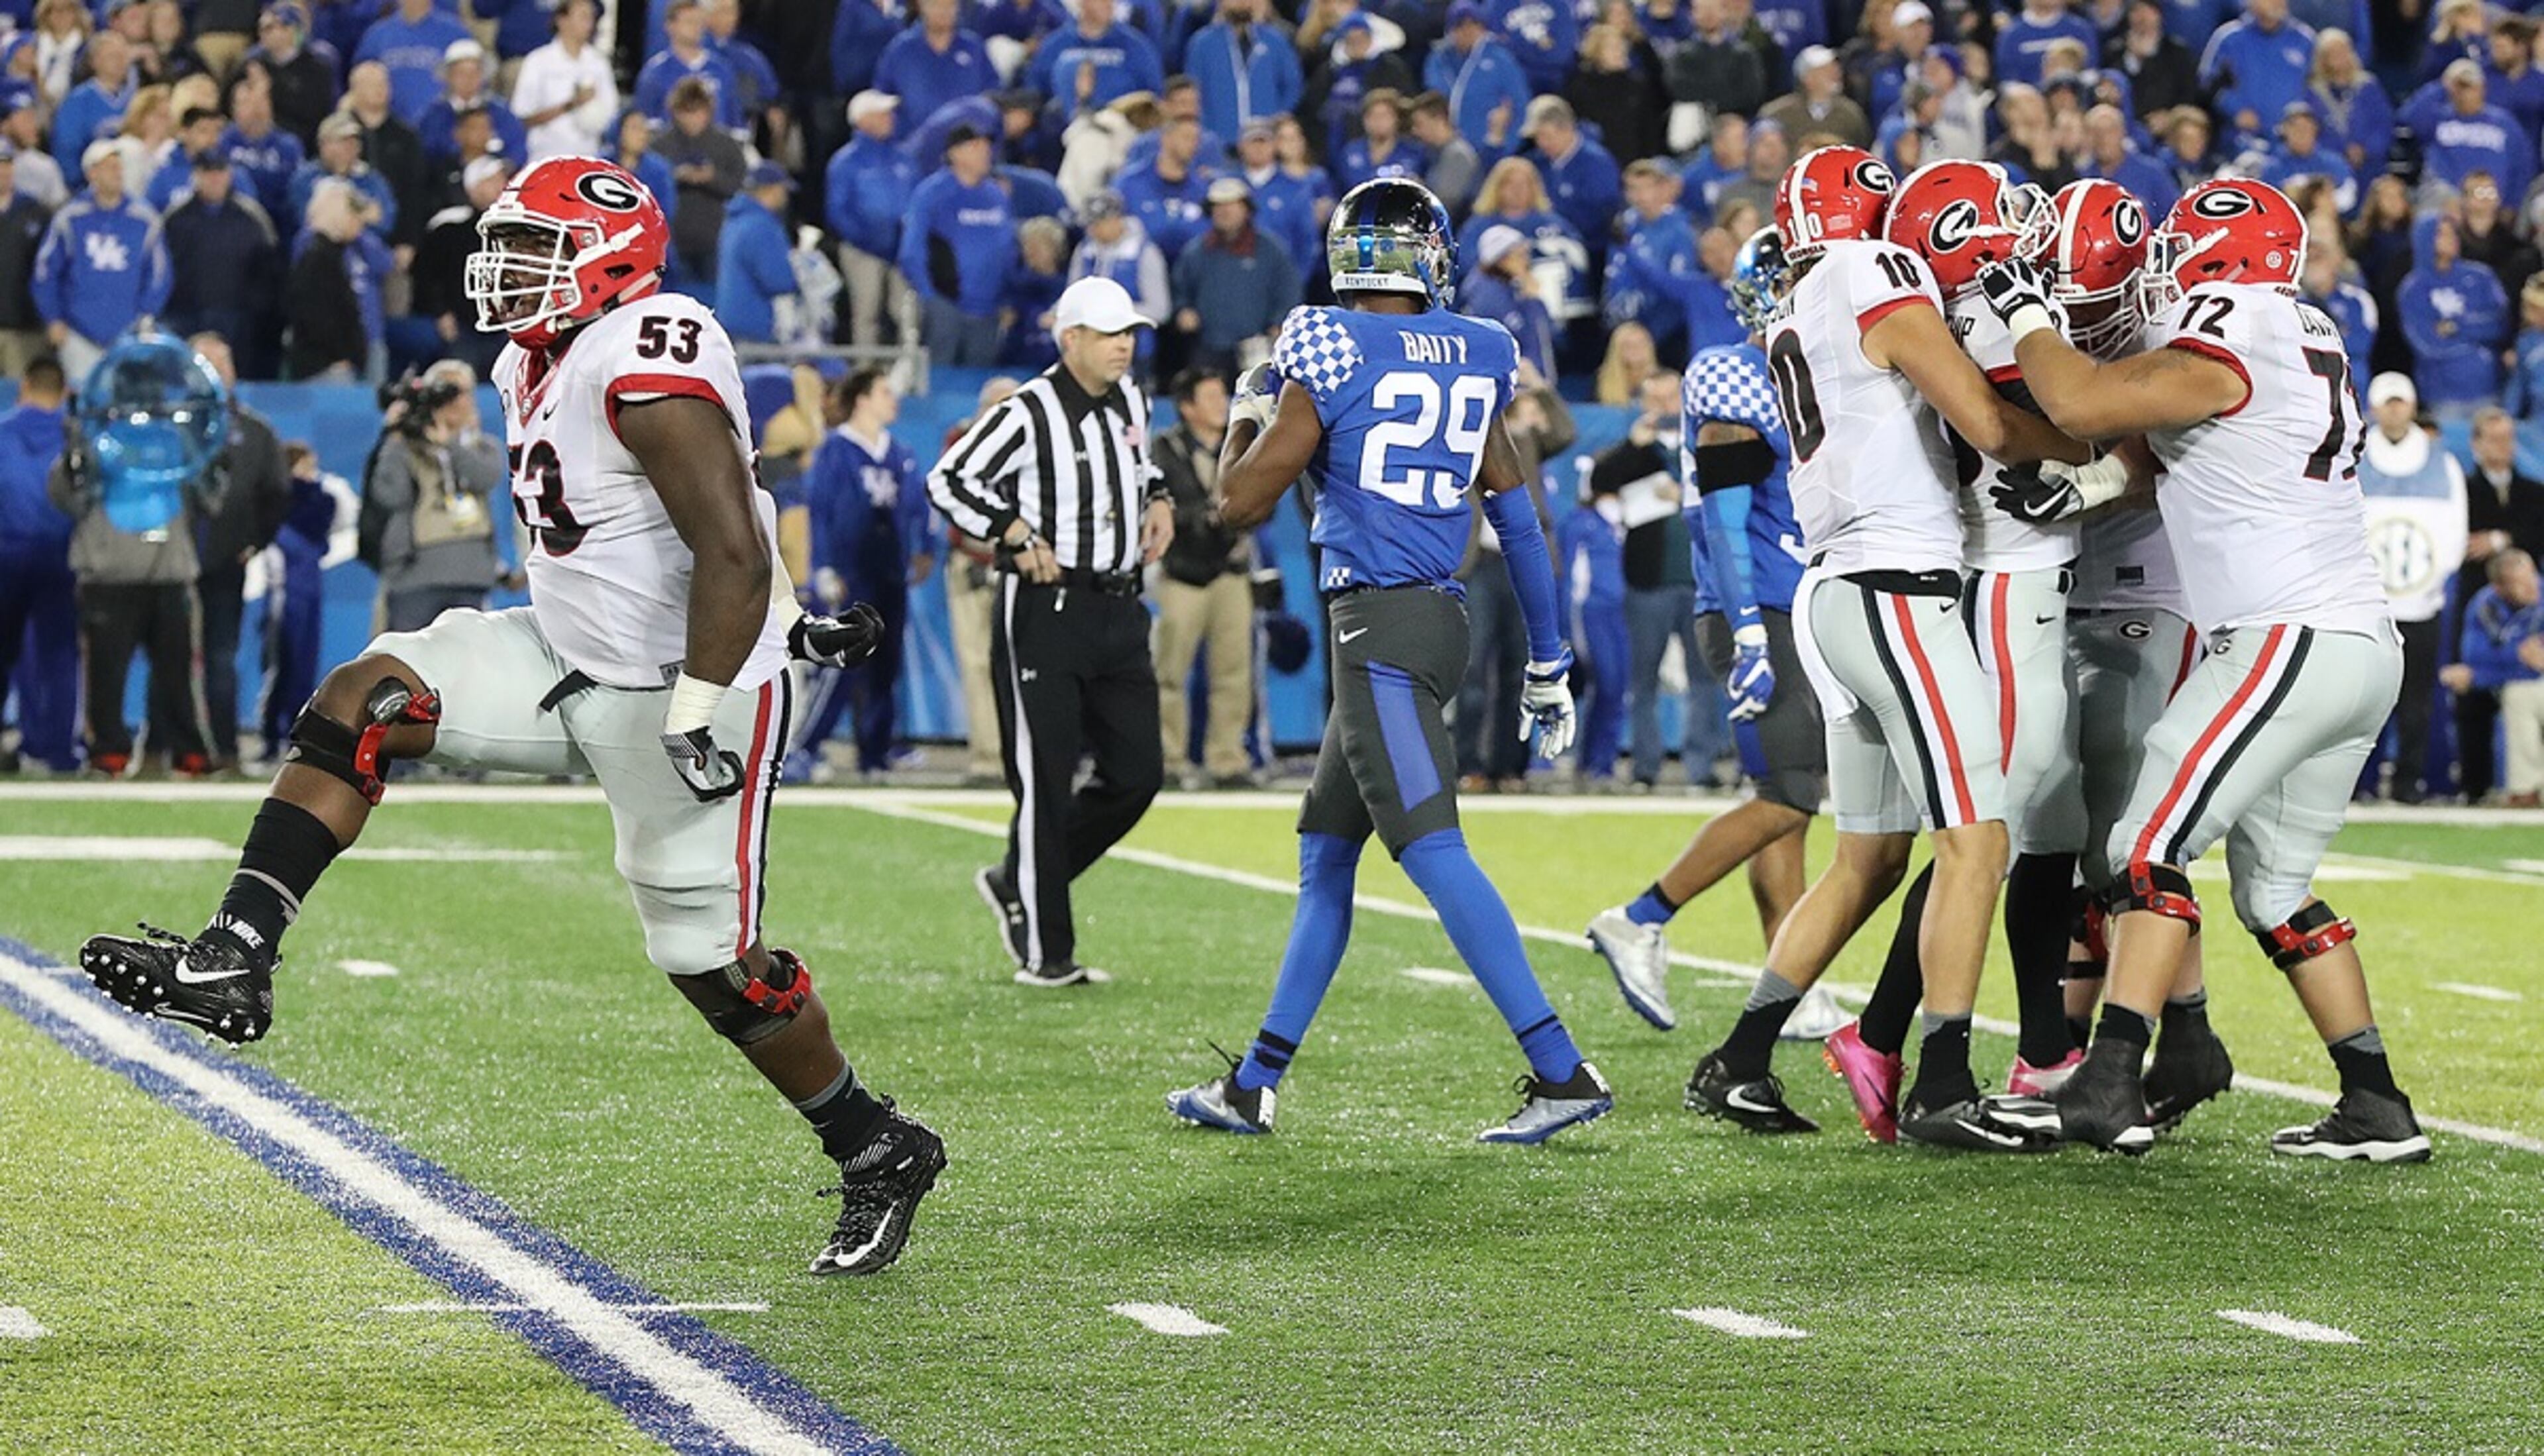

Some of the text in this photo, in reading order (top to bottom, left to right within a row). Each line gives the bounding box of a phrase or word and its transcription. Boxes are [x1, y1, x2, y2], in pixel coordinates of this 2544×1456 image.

[575, 172, 641, 213] G
[2192, 187, 2253, 220] G
[1345, 277, 1389, 287] KENTUCKY
[1876, 252, 1922, 289] 10
[2180, 294, 2234, 339] 72
[635, 316, 702, 364] 53
[1398, 331, 1467, 364] BAITY
[1359, 371, 1497, 509] 29
[227, 919, 265, 949] NIKE
